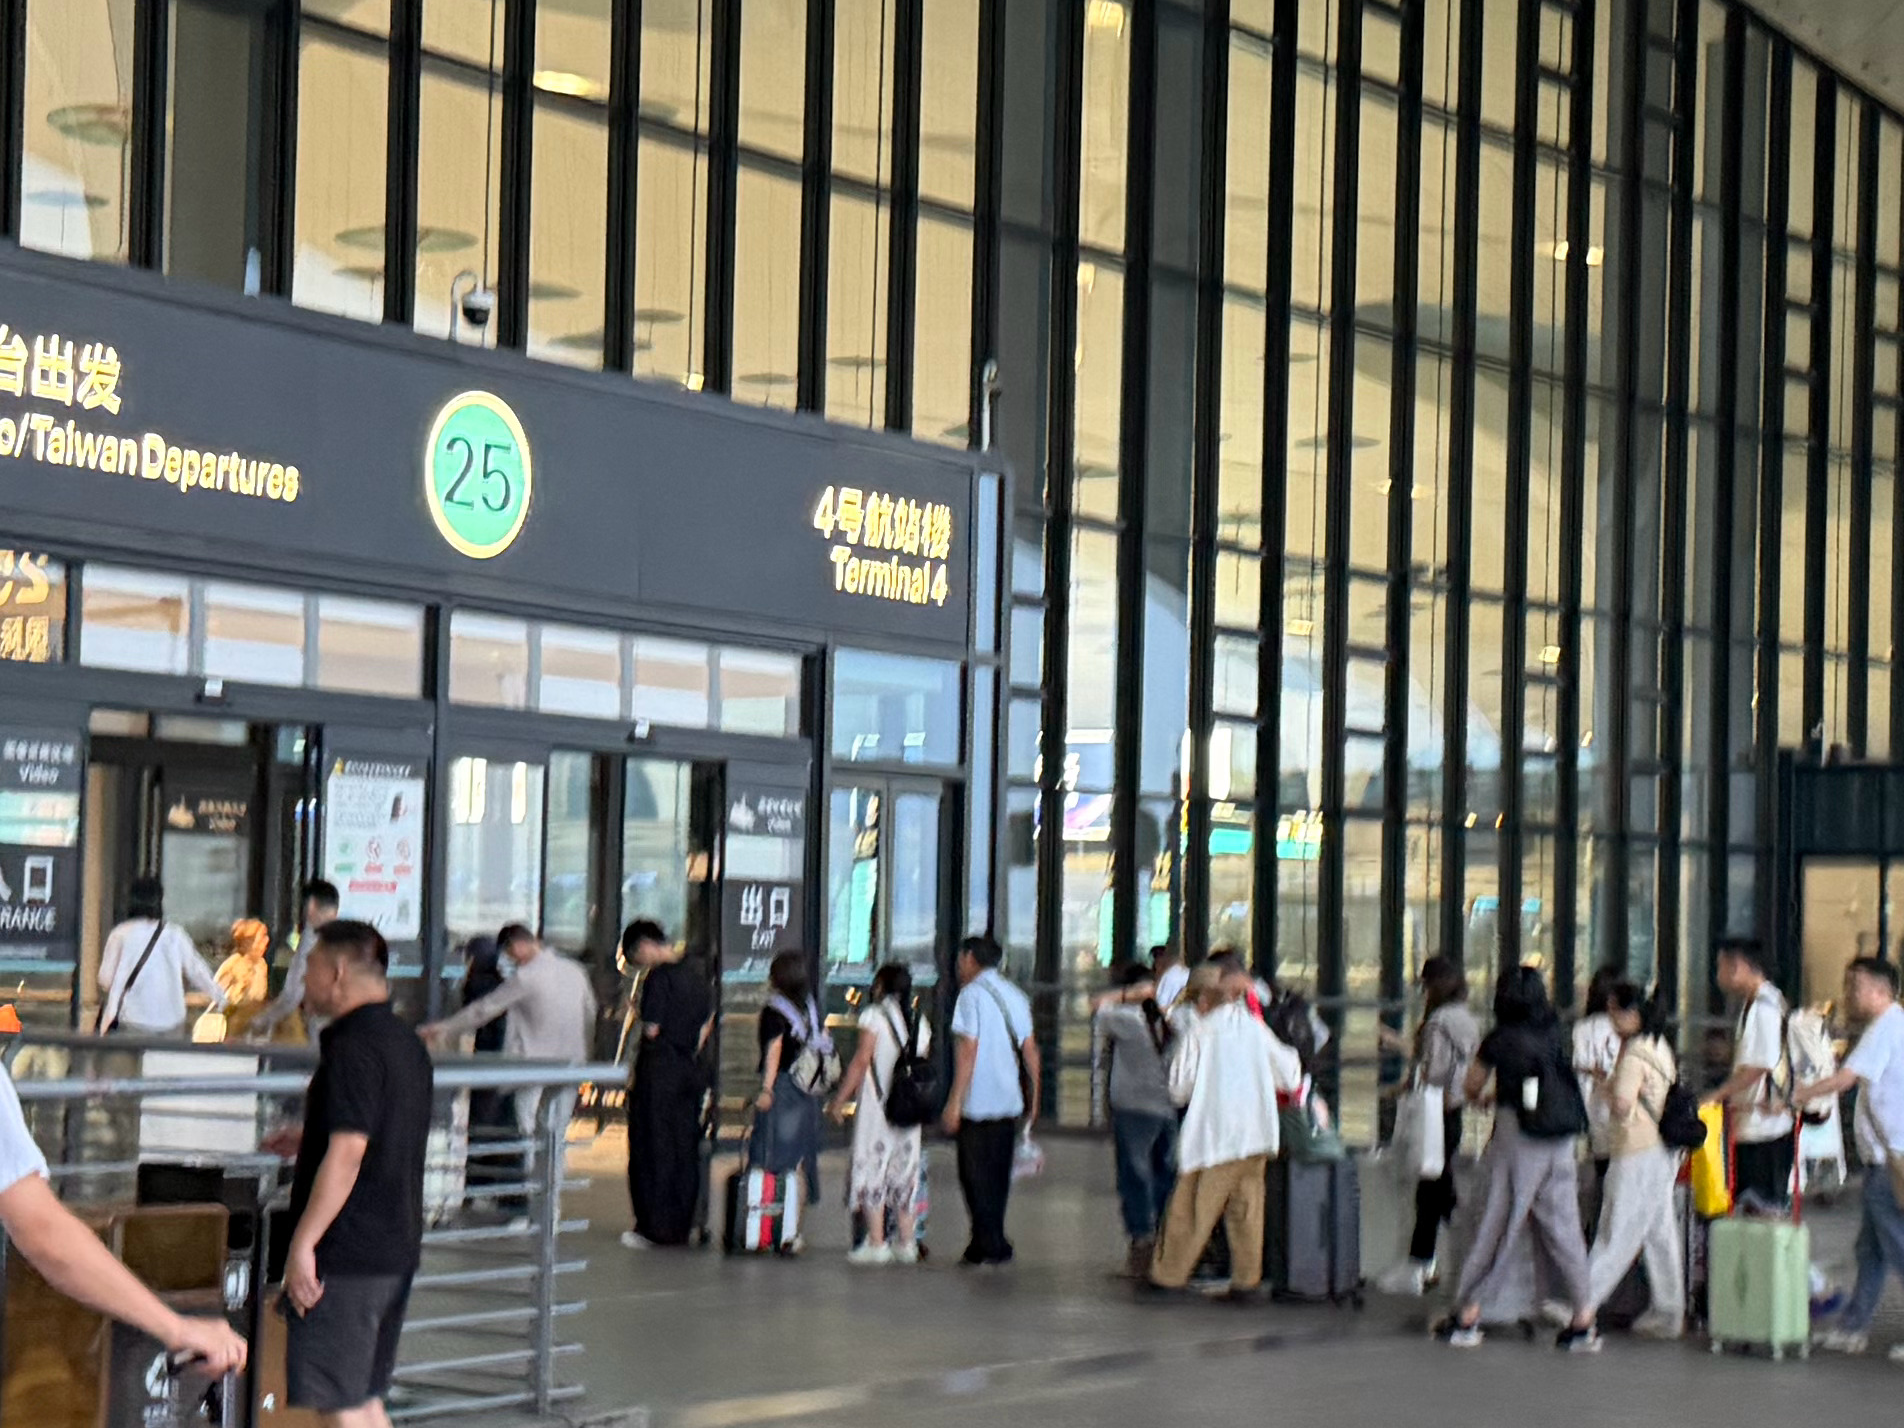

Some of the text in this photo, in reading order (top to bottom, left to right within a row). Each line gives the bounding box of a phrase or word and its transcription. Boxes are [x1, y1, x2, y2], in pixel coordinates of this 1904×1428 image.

[140, 432, 302, 503] Departures
[444, 436, 512, 513] 25
[813, 485, 951, 561] 4号航站楼
[830, 544, 949, 608] Terminal 4
[739, 883, 791, 930] 出口
